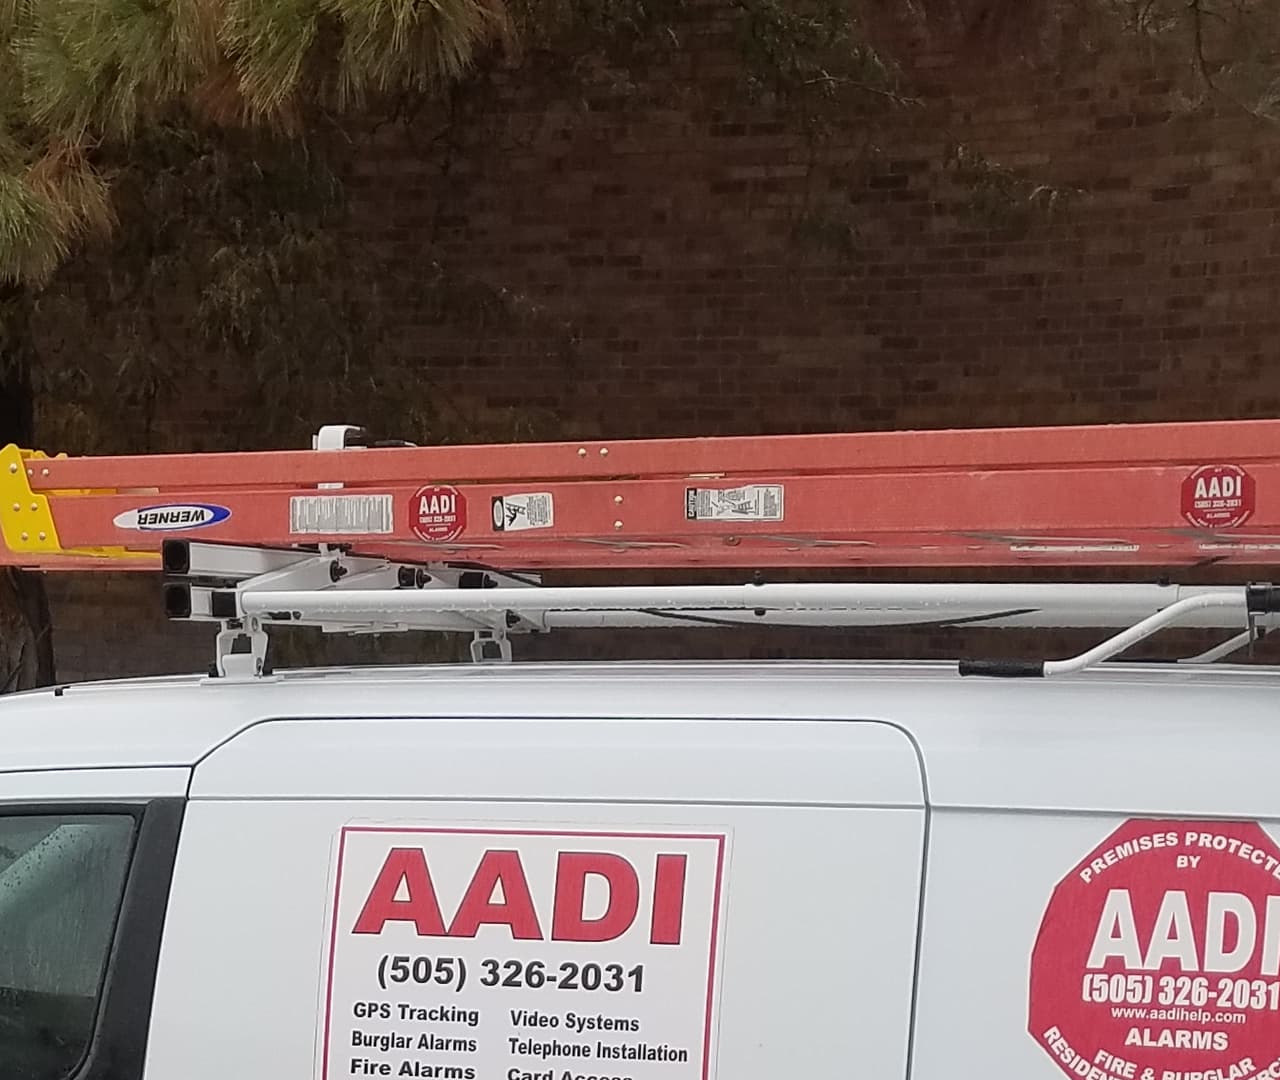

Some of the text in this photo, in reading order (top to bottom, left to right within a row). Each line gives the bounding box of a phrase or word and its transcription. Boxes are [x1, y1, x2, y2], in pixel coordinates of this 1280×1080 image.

[1194, 475, 1242, 498] AADI
[419, 494, 456, 515] AADI
[137, 509, 205, 525] WERNER
[1079, 832, 1179, 884] PREMISES
[1176, 855, 1201, 869] BY
[351, 847, 688, 945] AADI
[377, 954, 645, 993] (505) 326-2031
[1082, 973, 1280, 1011] (505) 326-2031
[353, 1002, 479, 1027] GPS Tracking
[510, 1009, 640, 1033] Video Systems
[1110, 1007, 1246, 1025] www.aadihelp.com
[351, 1030, 477, 1052] Burglar Alarms
[508, 1037, 688, 1063] Telephone Installation
[1124, 1027, 1229, 1051] ALARMS
[350, 1058, 476, 1080] Fire Alarms
[1093, 1049, 1138, 1079] FIRE
